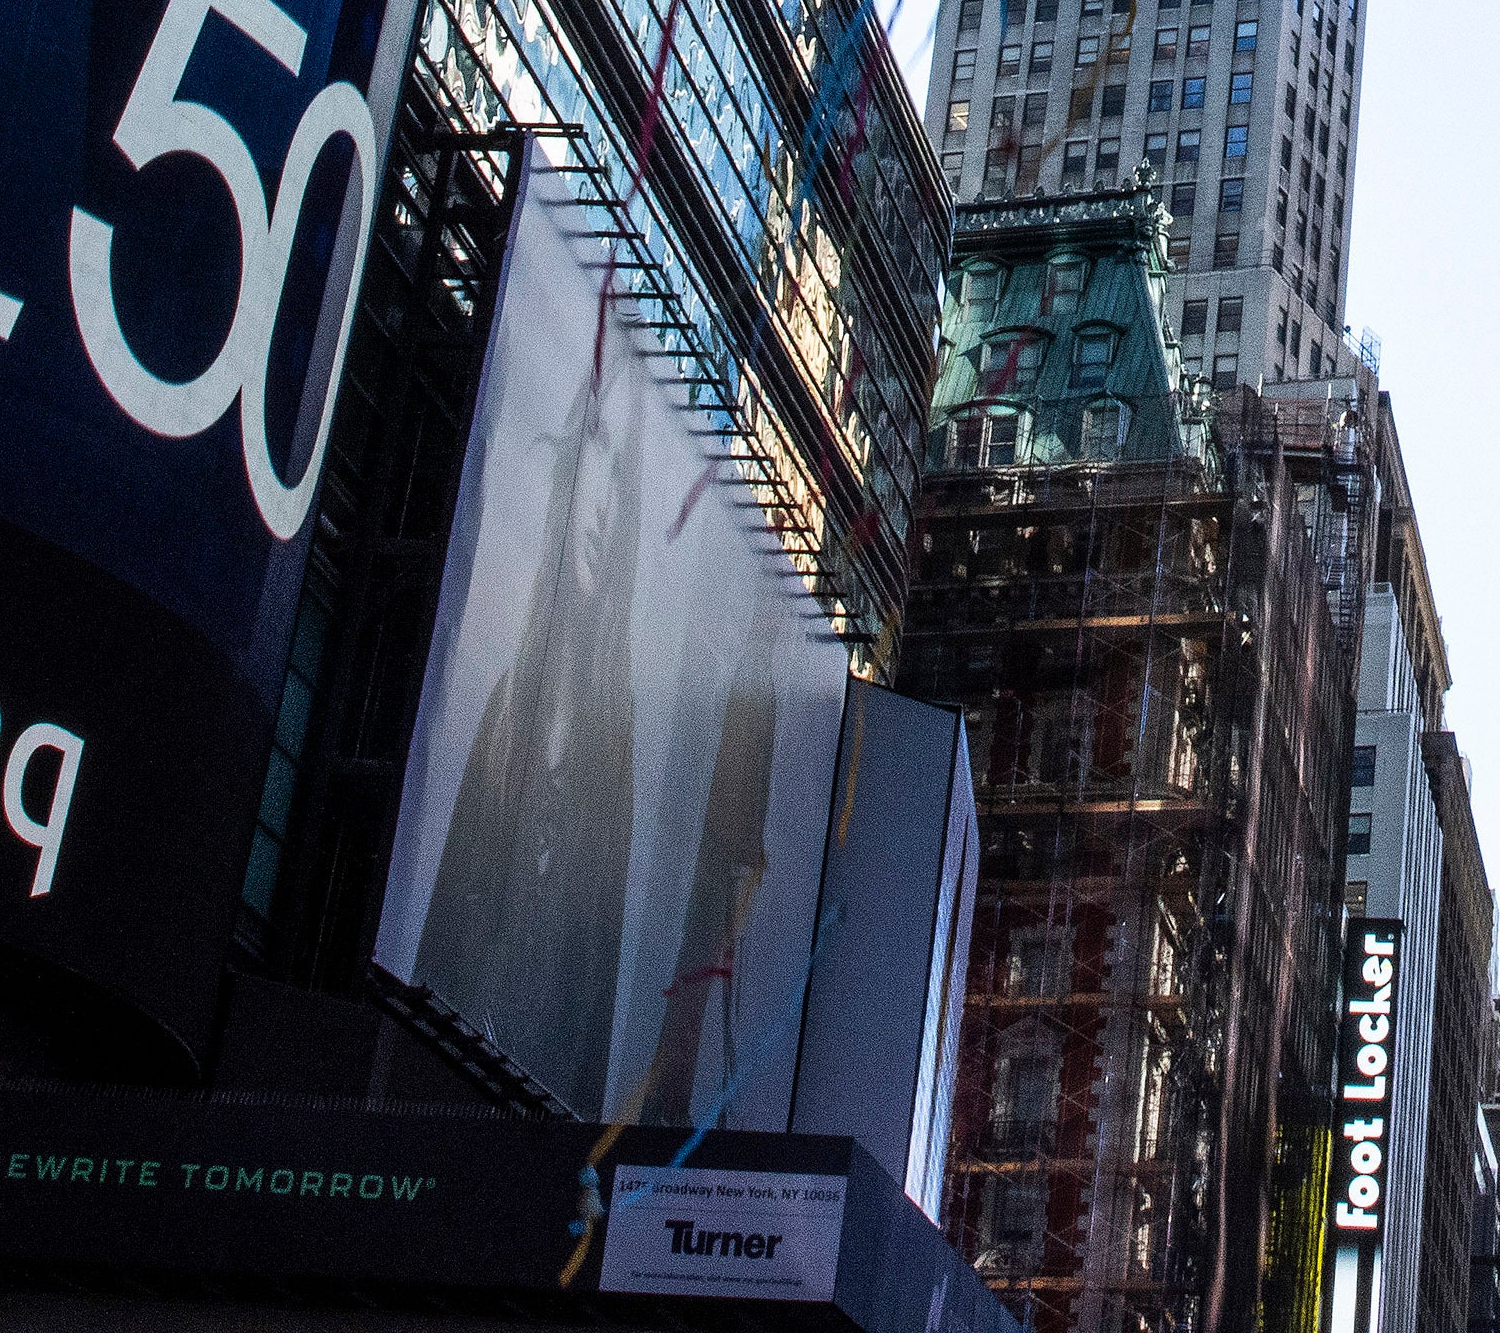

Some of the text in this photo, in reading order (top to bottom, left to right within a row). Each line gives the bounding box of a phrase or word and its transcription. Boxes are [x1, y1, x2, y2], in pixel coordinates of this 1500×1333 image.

[716, 1185, 745, 1199] New
[781, 1188, 800, 1200] NY
[1334, 1116, 1385, 1232] Foot
[664, 1219, 783, 1260] Turner
